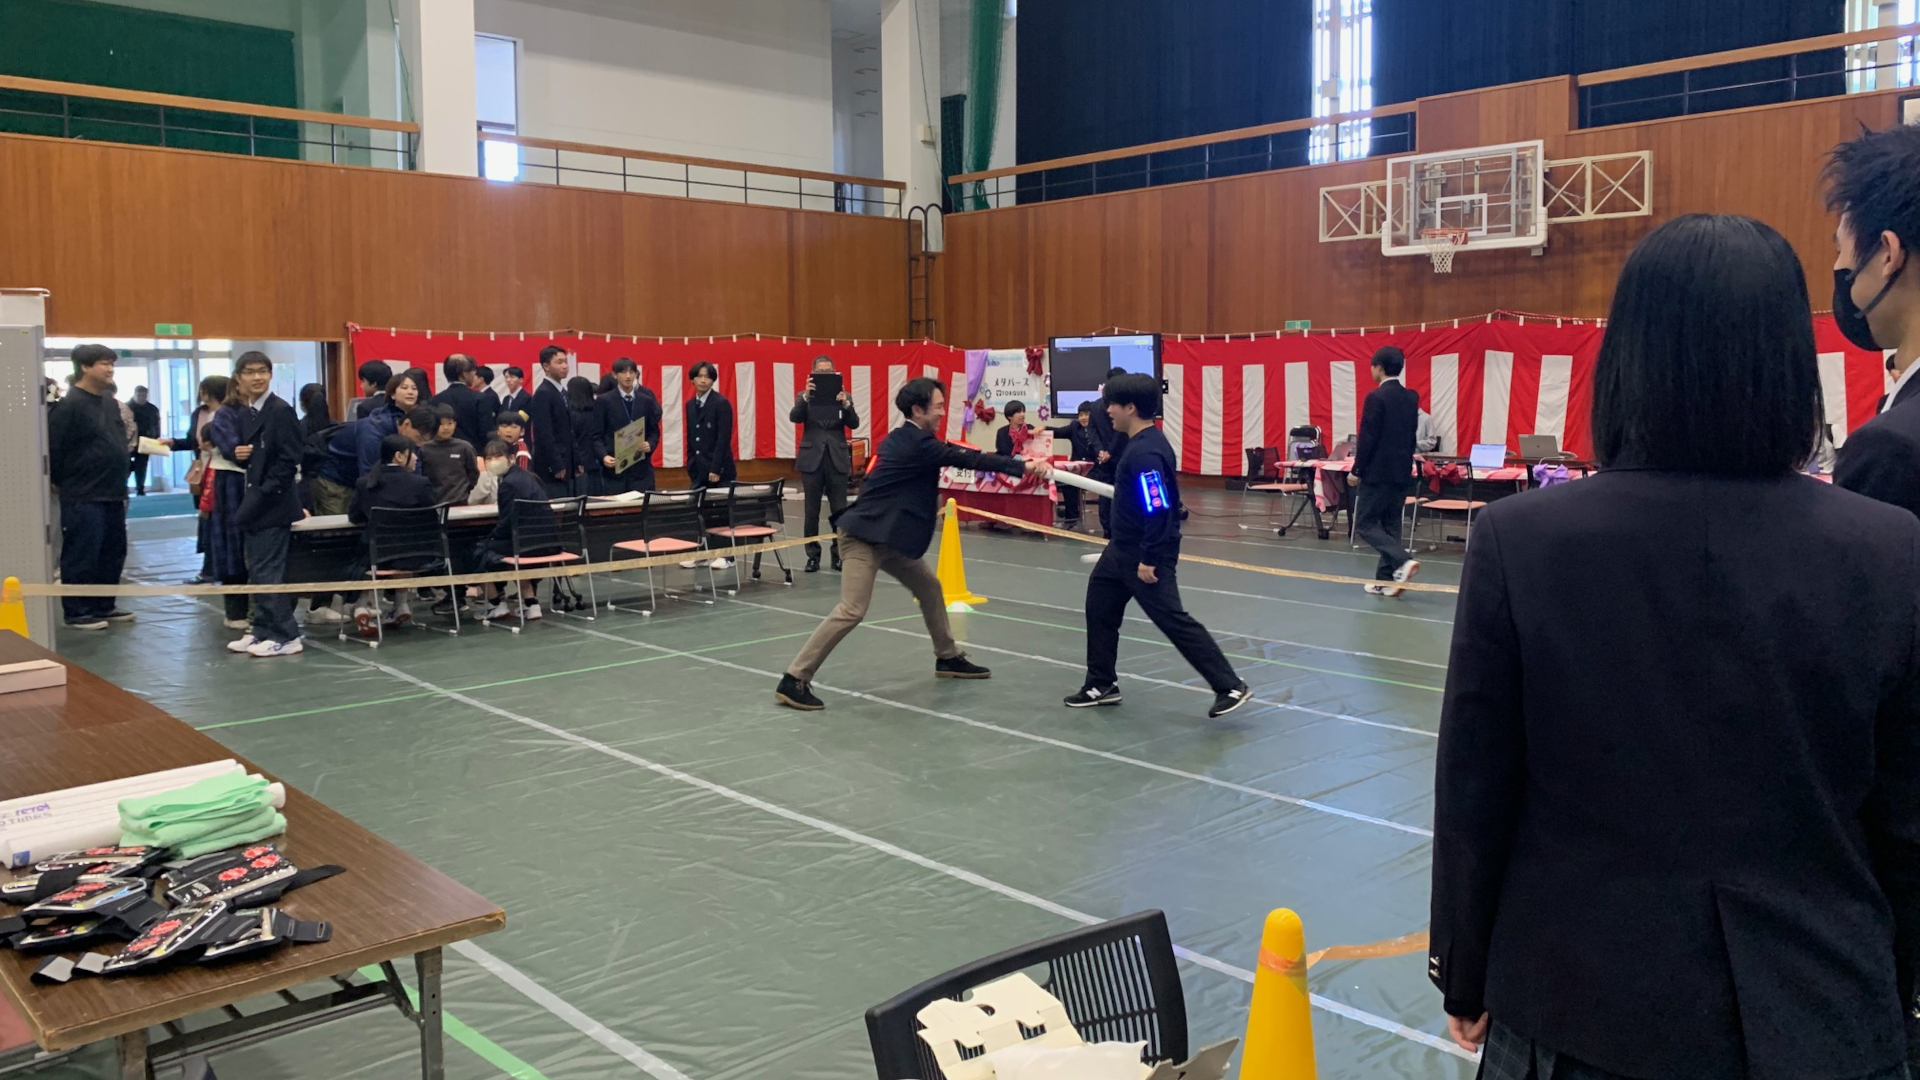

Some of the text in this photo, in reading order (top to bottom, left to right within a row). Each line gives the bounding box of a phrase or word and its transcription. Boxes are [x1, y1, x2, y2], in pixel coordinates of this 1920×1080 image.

[994, 377, 1029, 387] メタバース
